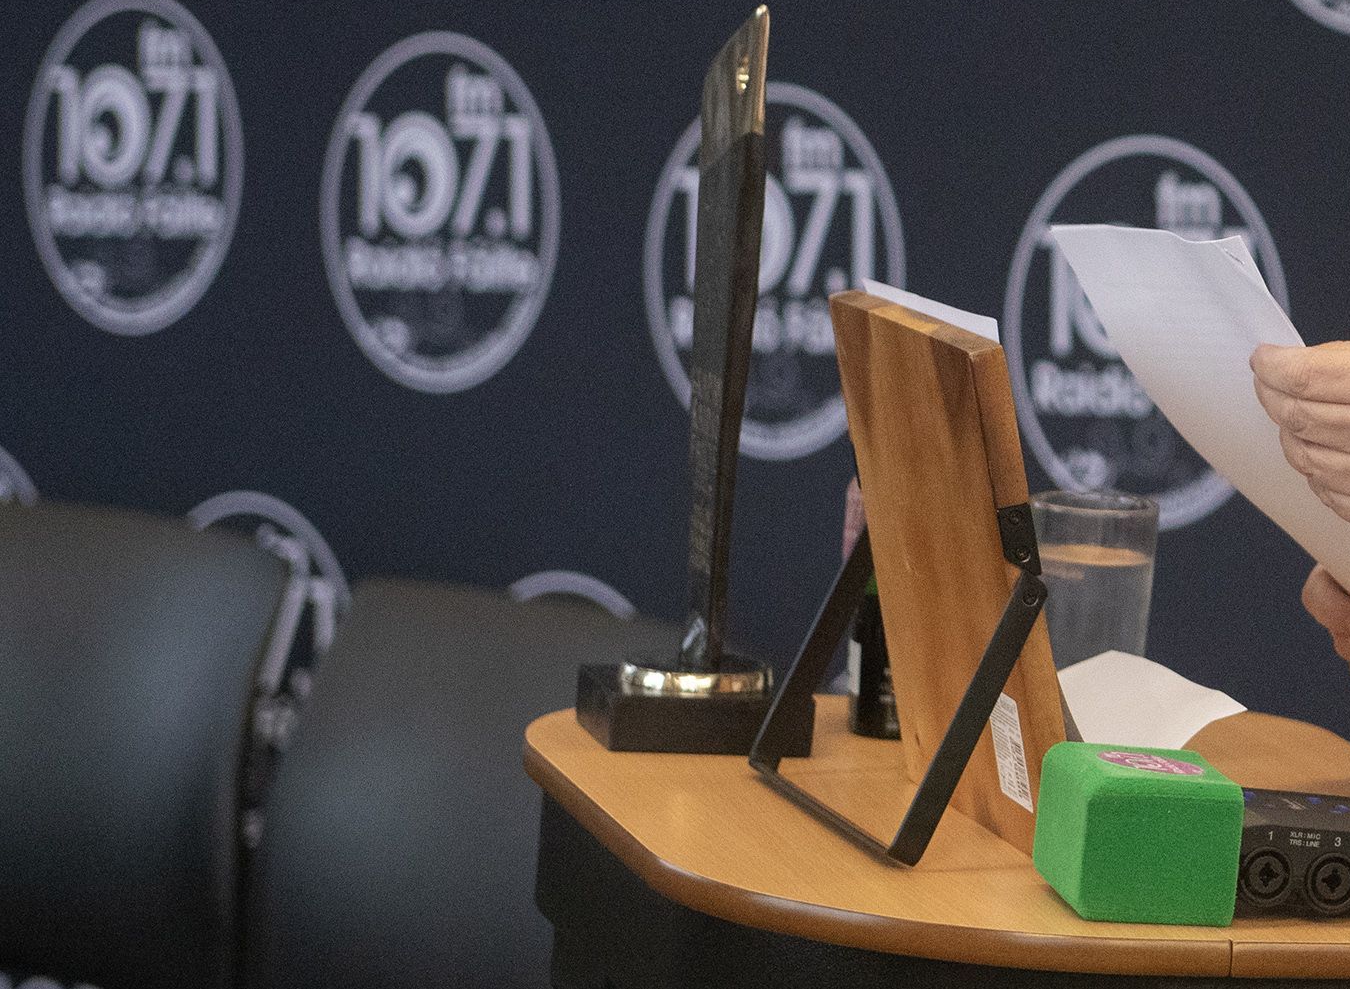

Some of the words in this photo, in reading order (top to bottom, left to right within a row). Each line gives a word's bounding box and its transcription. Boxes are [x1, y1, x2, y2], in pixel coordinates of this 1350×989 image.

[52, 67, 216, 183] 107.1
[351, 115, 529, 235] 107.1
[1334, 836, 1342, 847] 3
